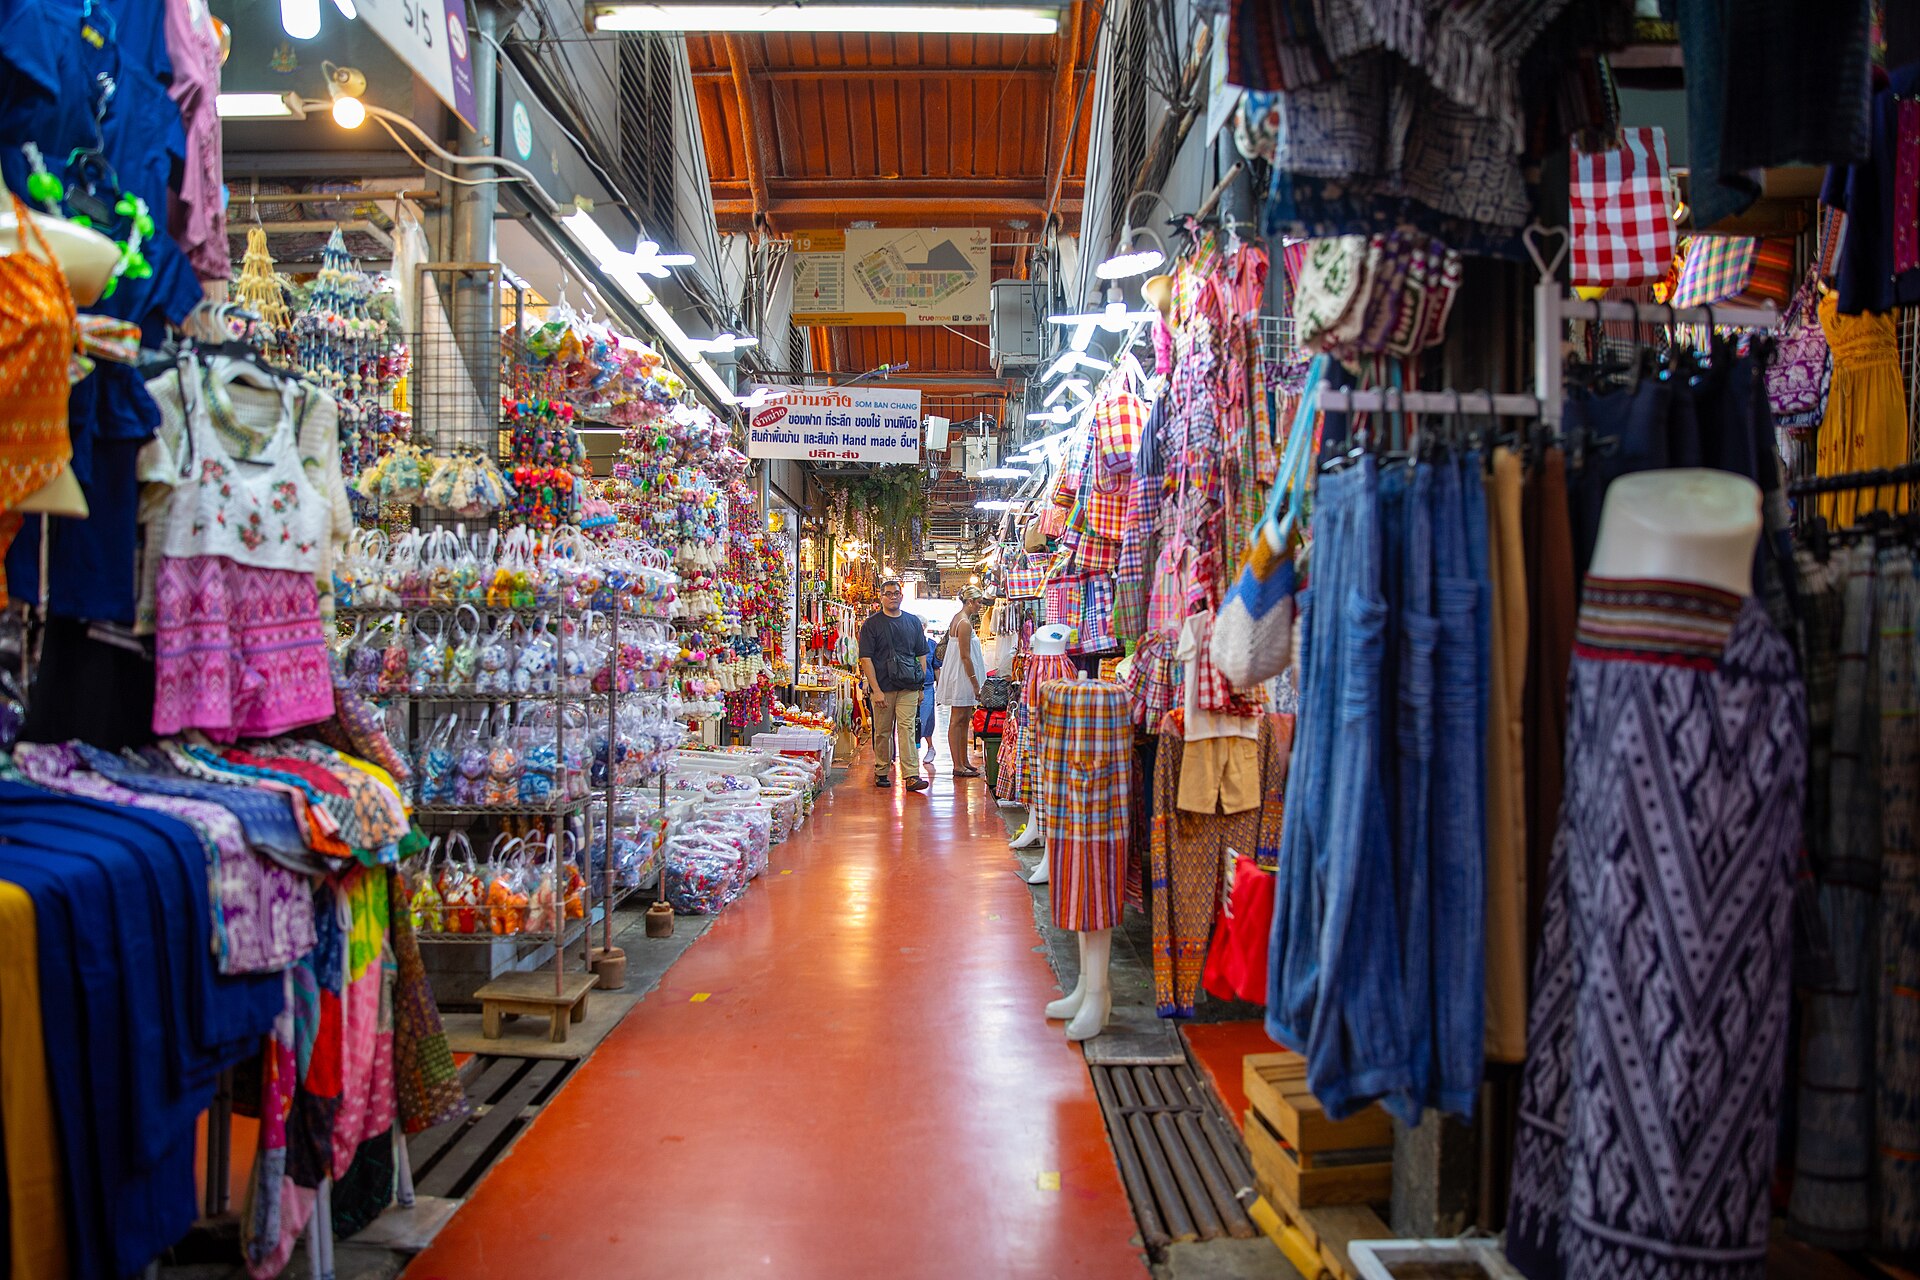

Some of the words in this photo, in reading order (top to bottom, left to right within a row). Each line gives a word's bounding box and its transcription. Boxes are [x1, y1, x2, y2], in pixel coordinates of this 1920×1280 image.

[796, 239, 811, 250] 19
[855, 400, 872, 408] SOM
[874, 401, 889, 409] BAN
[890, 402, 918, 410] CHANG
[755, 408, 785, 426] จำหน่าย
[788, 413, 821, 425] ของฝาก
[855, 413, 881, 428] ของใช้
[842, 434, 867, 446] Hand
[870, 436, 897, 447] made
[900, 431, 918, 450] อื่นๆ
[808, 448, 860, 459] ปลีก-ส่ง
